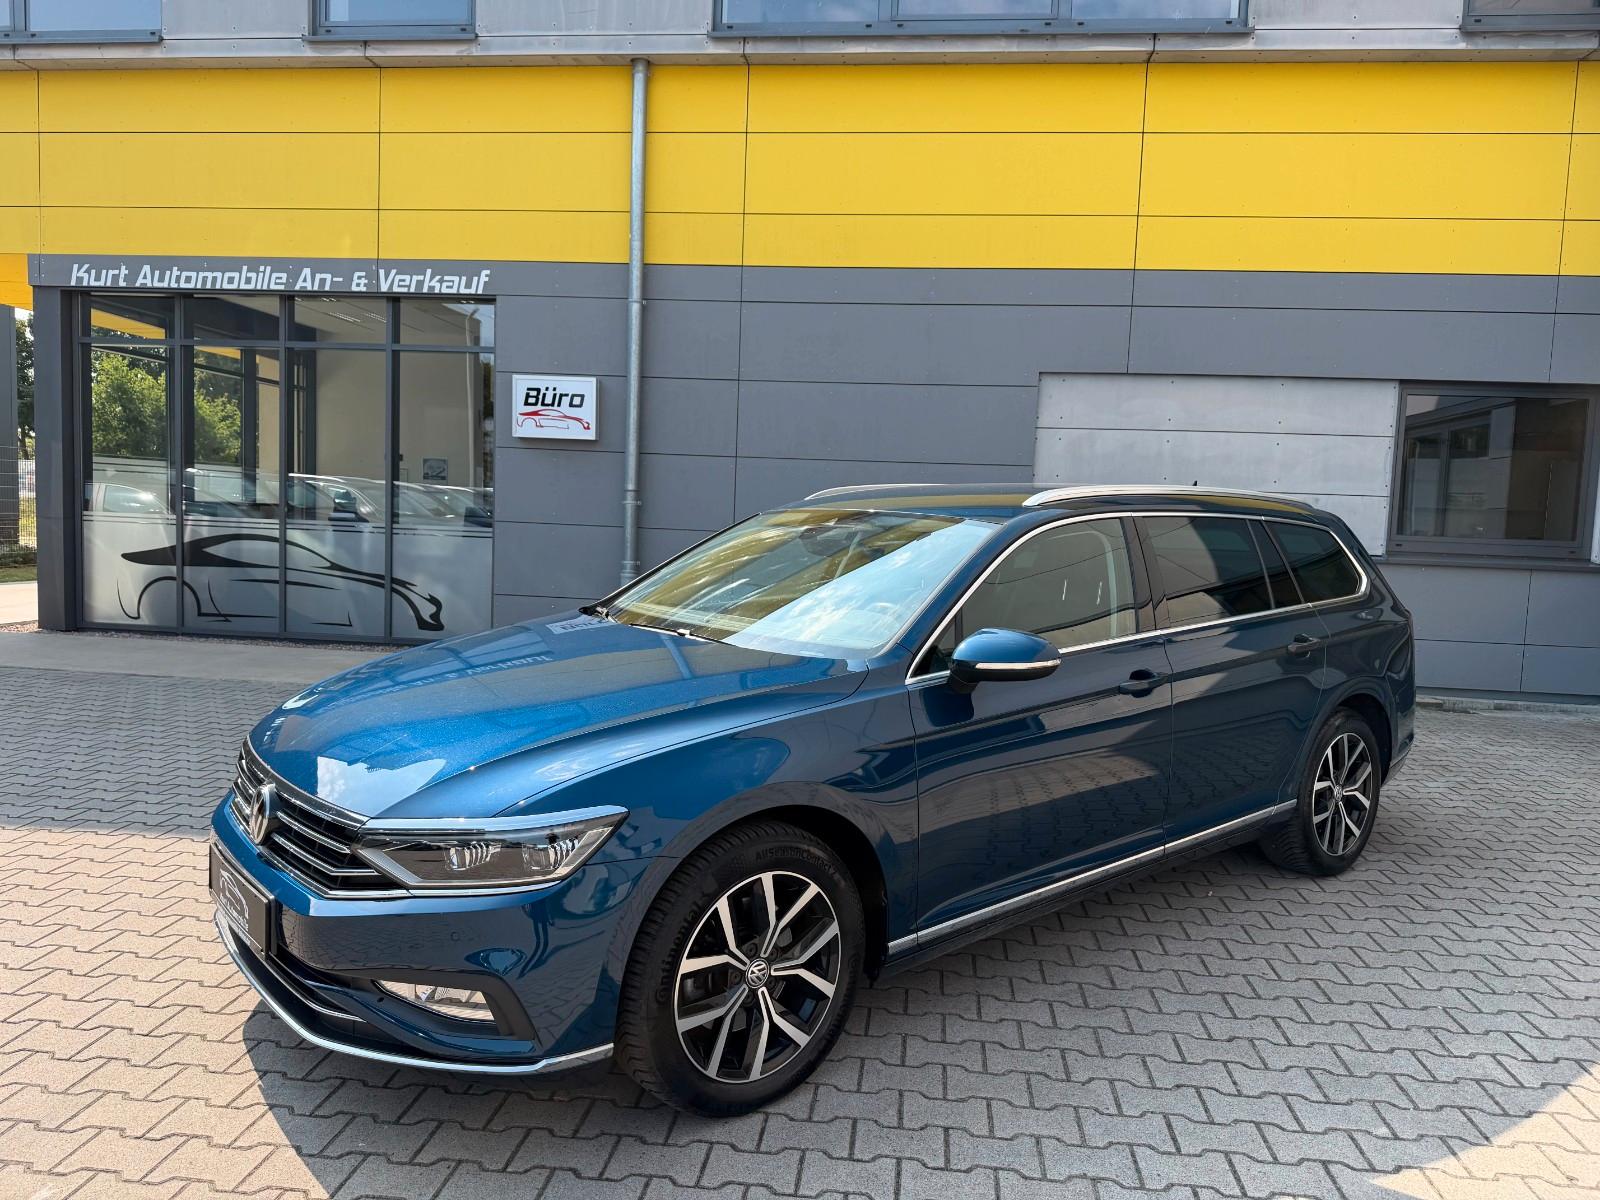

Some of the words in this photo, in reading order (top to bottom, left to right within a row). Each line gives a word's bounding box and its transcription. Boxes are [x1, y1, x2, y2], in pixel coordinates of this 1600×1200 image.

[70, 263, 129, 286] Kurt
[135, 264, 288, 290] Automobile
[294, 267, 344, 291] An-
[351, 271, 368, 292] &
[378, 268, 491, 295] Verkauf
[523, 386, 586, 408] Büro
